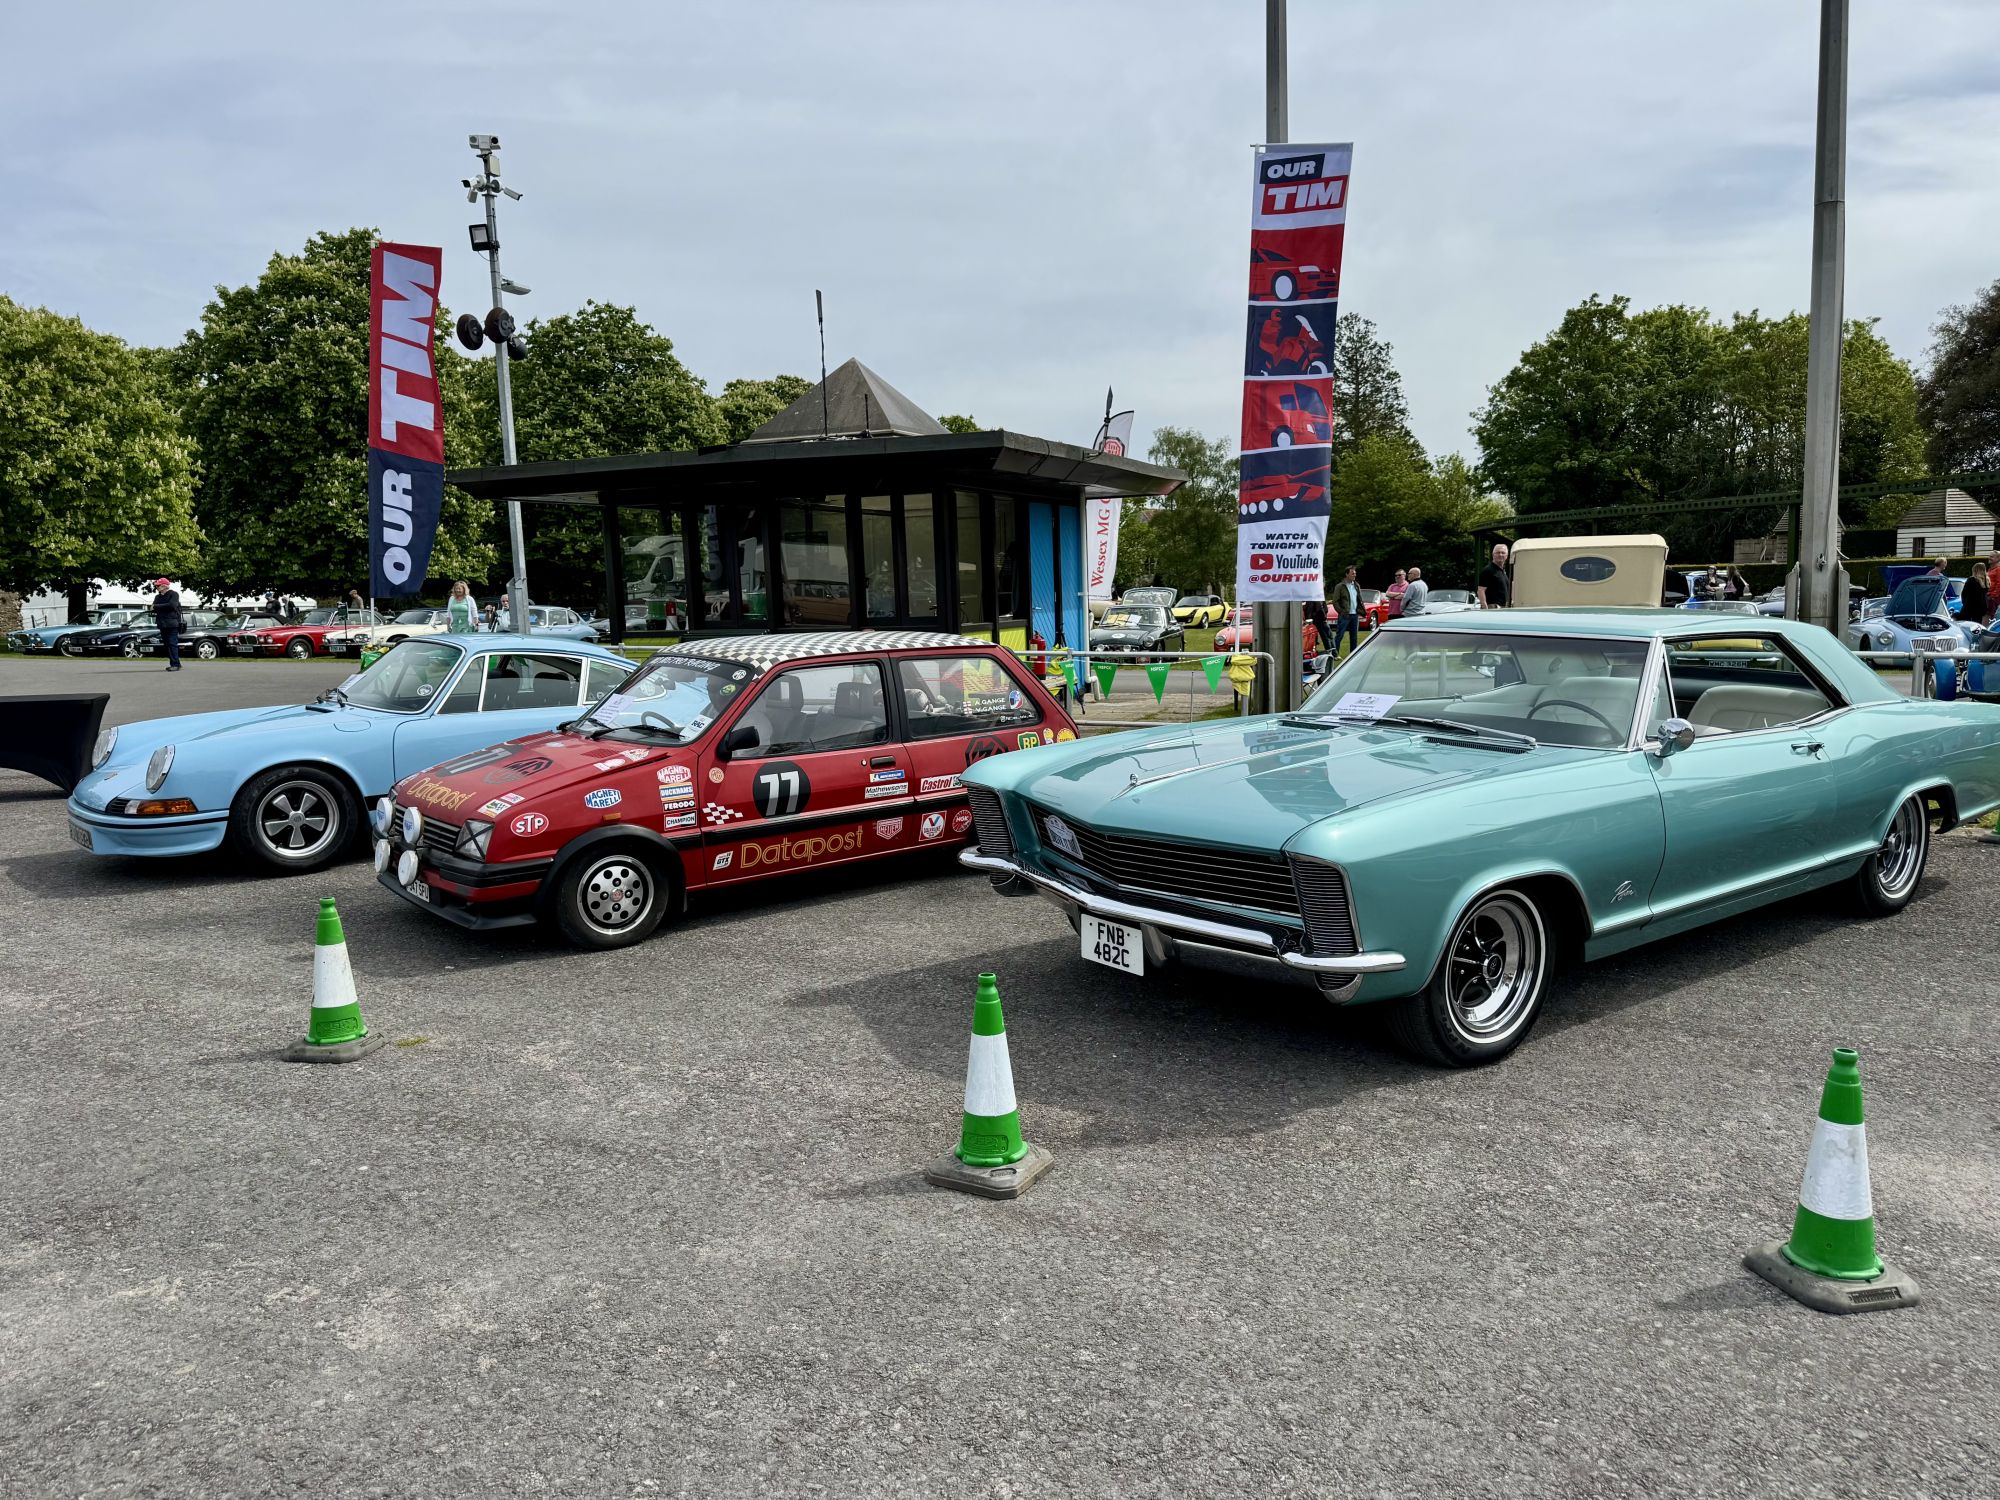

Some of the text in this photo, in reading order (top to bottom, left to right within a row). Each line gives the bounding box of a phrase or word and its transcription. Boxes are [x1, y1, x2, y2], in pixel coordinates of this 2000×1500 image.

[1267, 160, 1316, 179] OUR
[1267, 179, 1343, 211] TIM
[381, 250, 435, 586] OUR TIM
[1096, 509, 1111, 536] MG
[1249, 542, 1319, 550] TONIGHT ON
[1265, 532, 1309, 541] WATCH
[1091, 540, 1108, 587] Wessex
[1276, 553, 1319, 569] YouTube
[1248, 573, 1319, 584] @OURTIM
[1022, 736, 1037, 749] BP
[660, 786, 693, 797] DUCKHAMS
[866, 784, 908, 794] Mathewsons
[921, 776, 953, 791] Castrol
[406, 777, 477, 811] Datapost
[760, 771, 799, 816] 77
[664, 800, 695, 811] FERODO
[515, 814, 545, 833] STP
[666, 815, 695, 826] CHAMPION
[740, 825, 864, 869] Datapost
[1097, 921, 1125, 947] FNB
[1094, 941, 1130, 968] 482C
